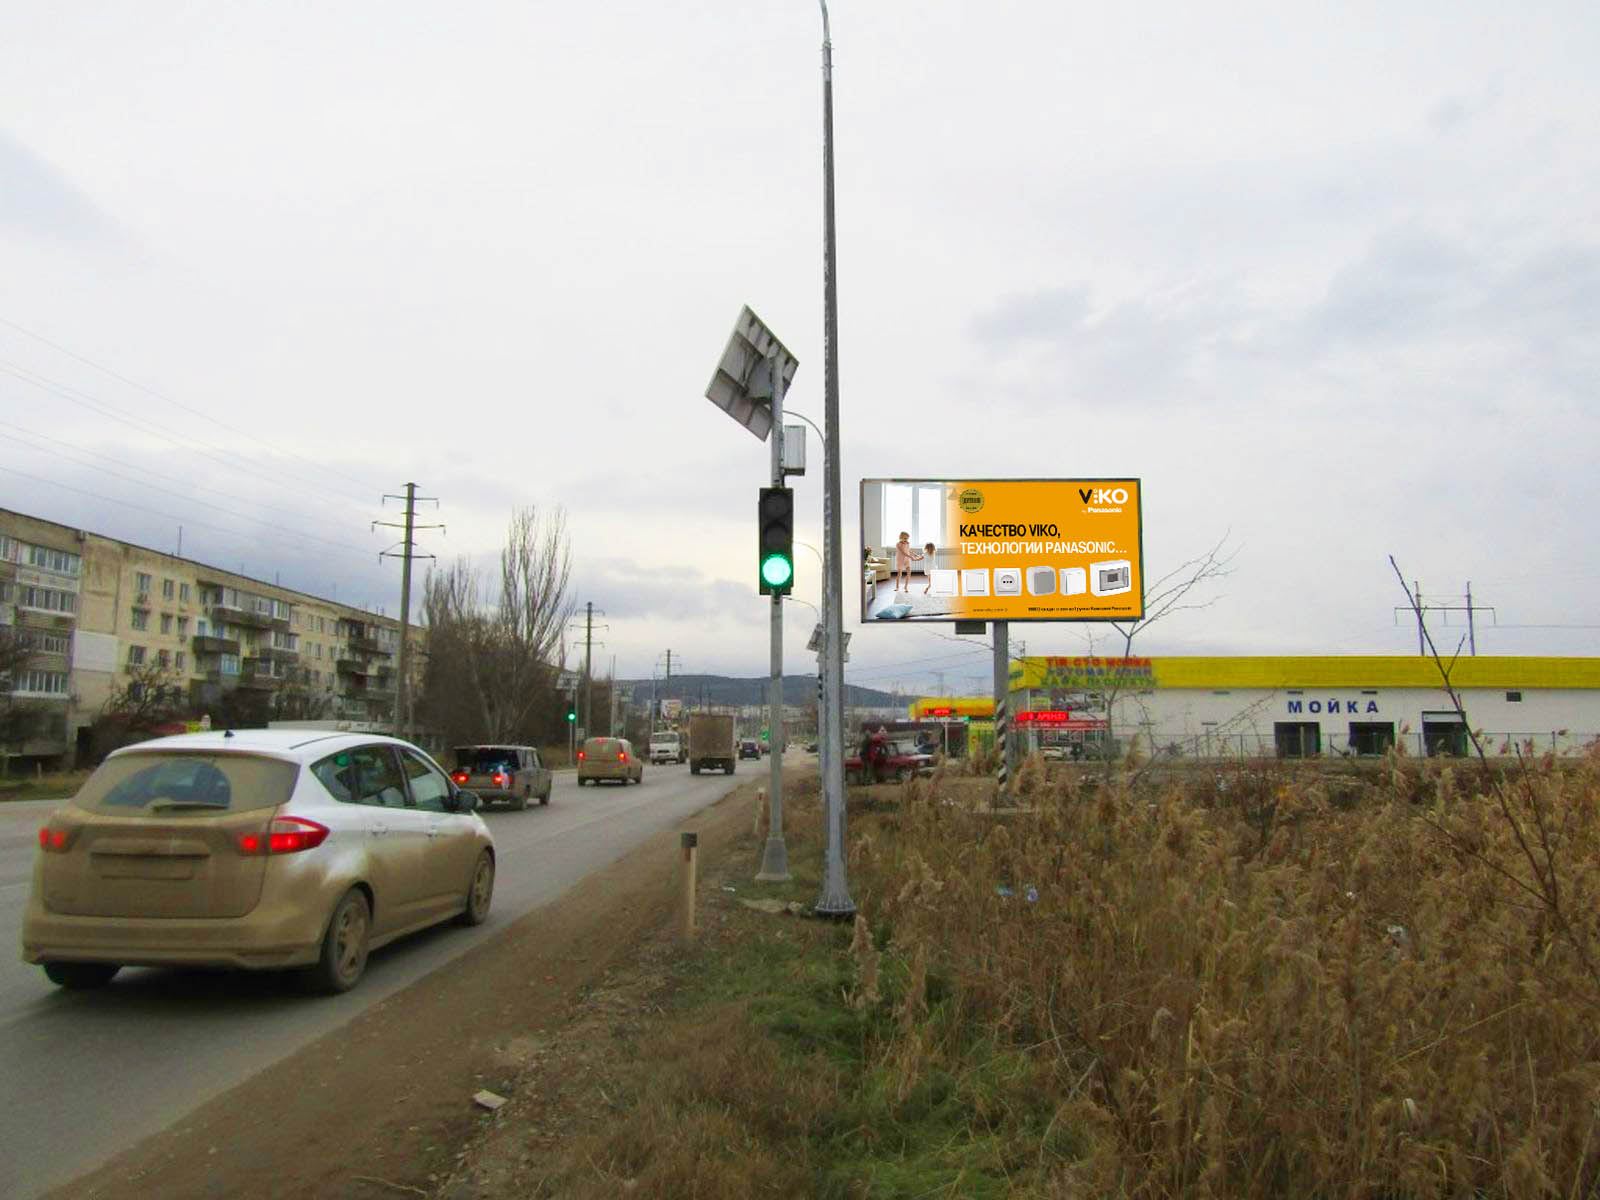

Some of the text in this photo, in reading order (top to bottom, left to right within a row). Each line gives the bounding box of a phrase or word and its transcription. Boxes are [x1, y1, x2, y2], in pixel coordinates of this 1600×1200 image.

[959, 524, 1061, 539] КАЧЕСТВО VIKO,
[960, 541, 1043, 554] ТЕХНОЛОГИИ
[1288, 698, 1379, 713] МОЙКА
